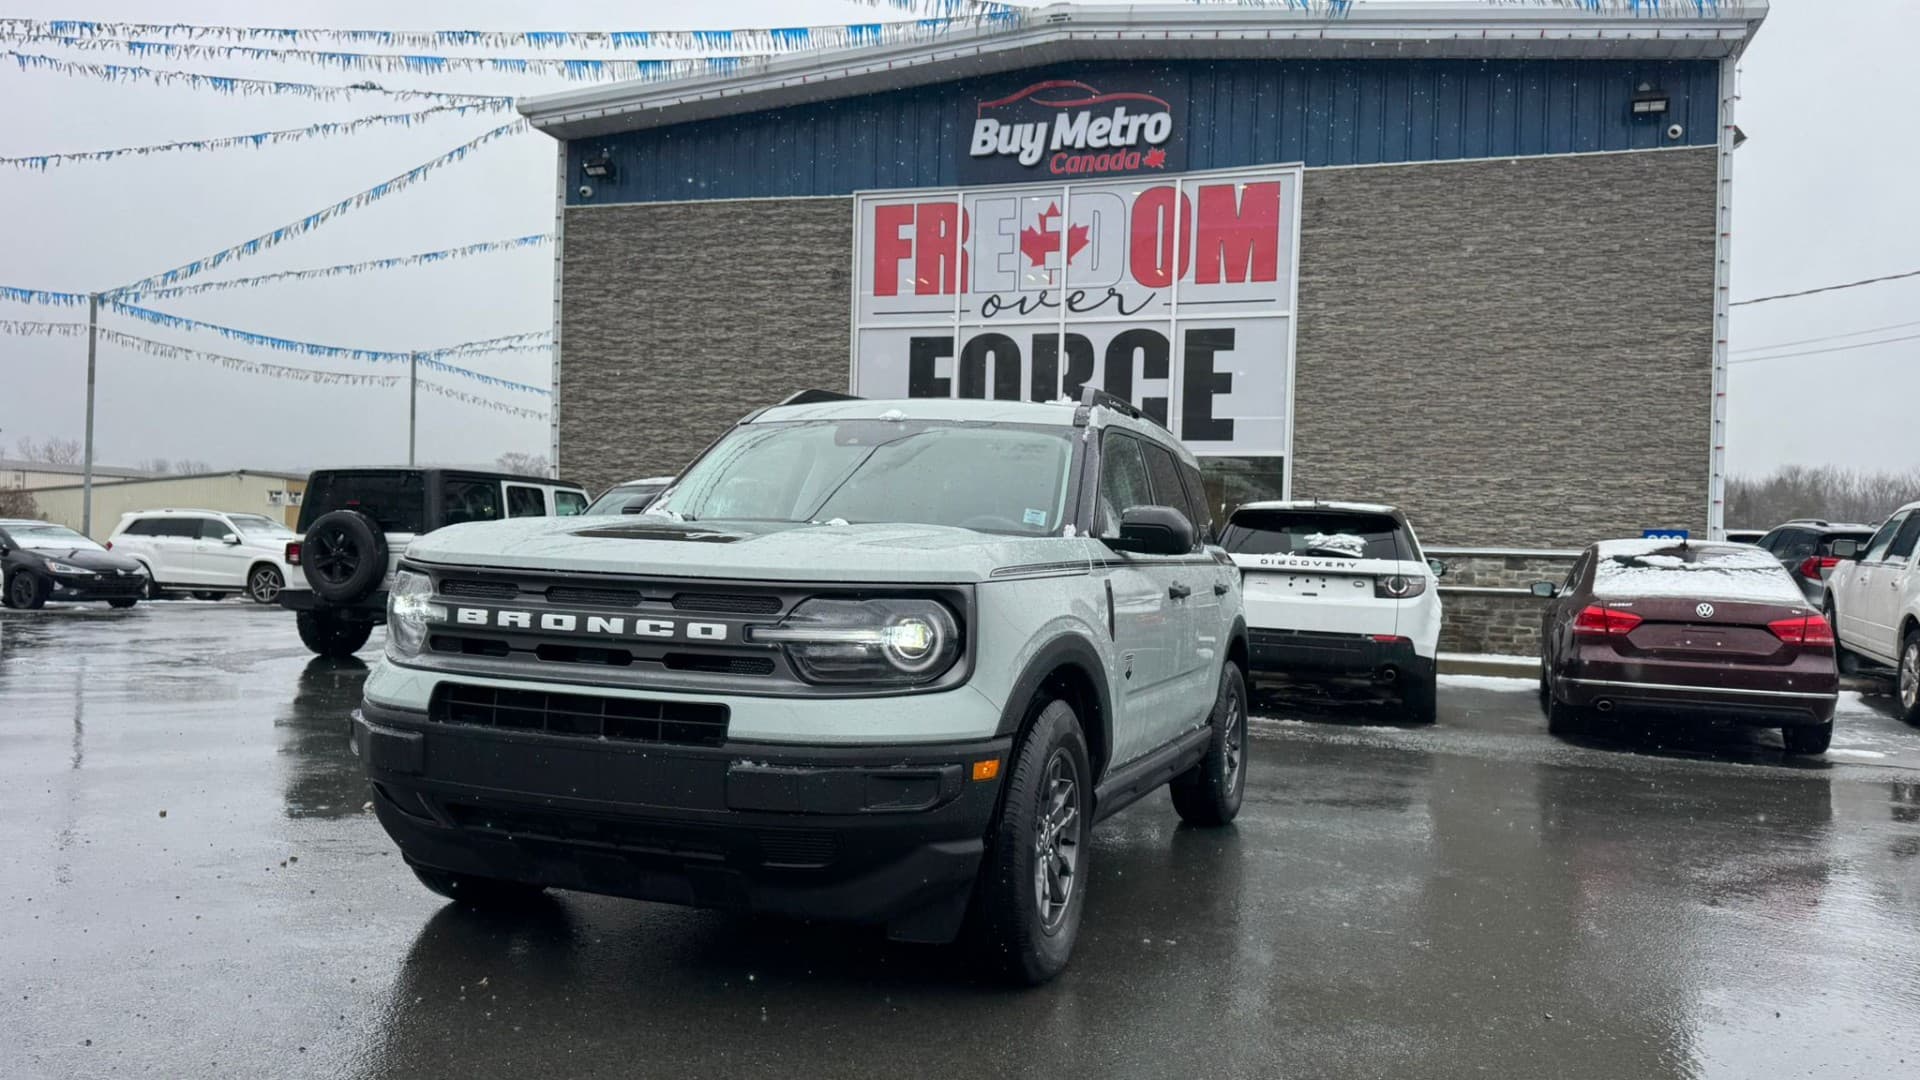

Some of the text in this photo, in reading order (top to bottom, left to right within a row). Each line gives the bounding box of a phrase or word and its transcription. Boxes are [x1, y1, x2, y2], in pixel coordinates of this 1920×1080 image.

[970, 107, 1172, 165] Buy Metro
[1049, 148, 1141, 174] Canada
[873, 181, 1280, 296] FREEDOM
[981, 287, 1156, 318] over
[1260, 558, 1357, 568] DISCOVERY
[457, 607, 727, 640] BRONCO
